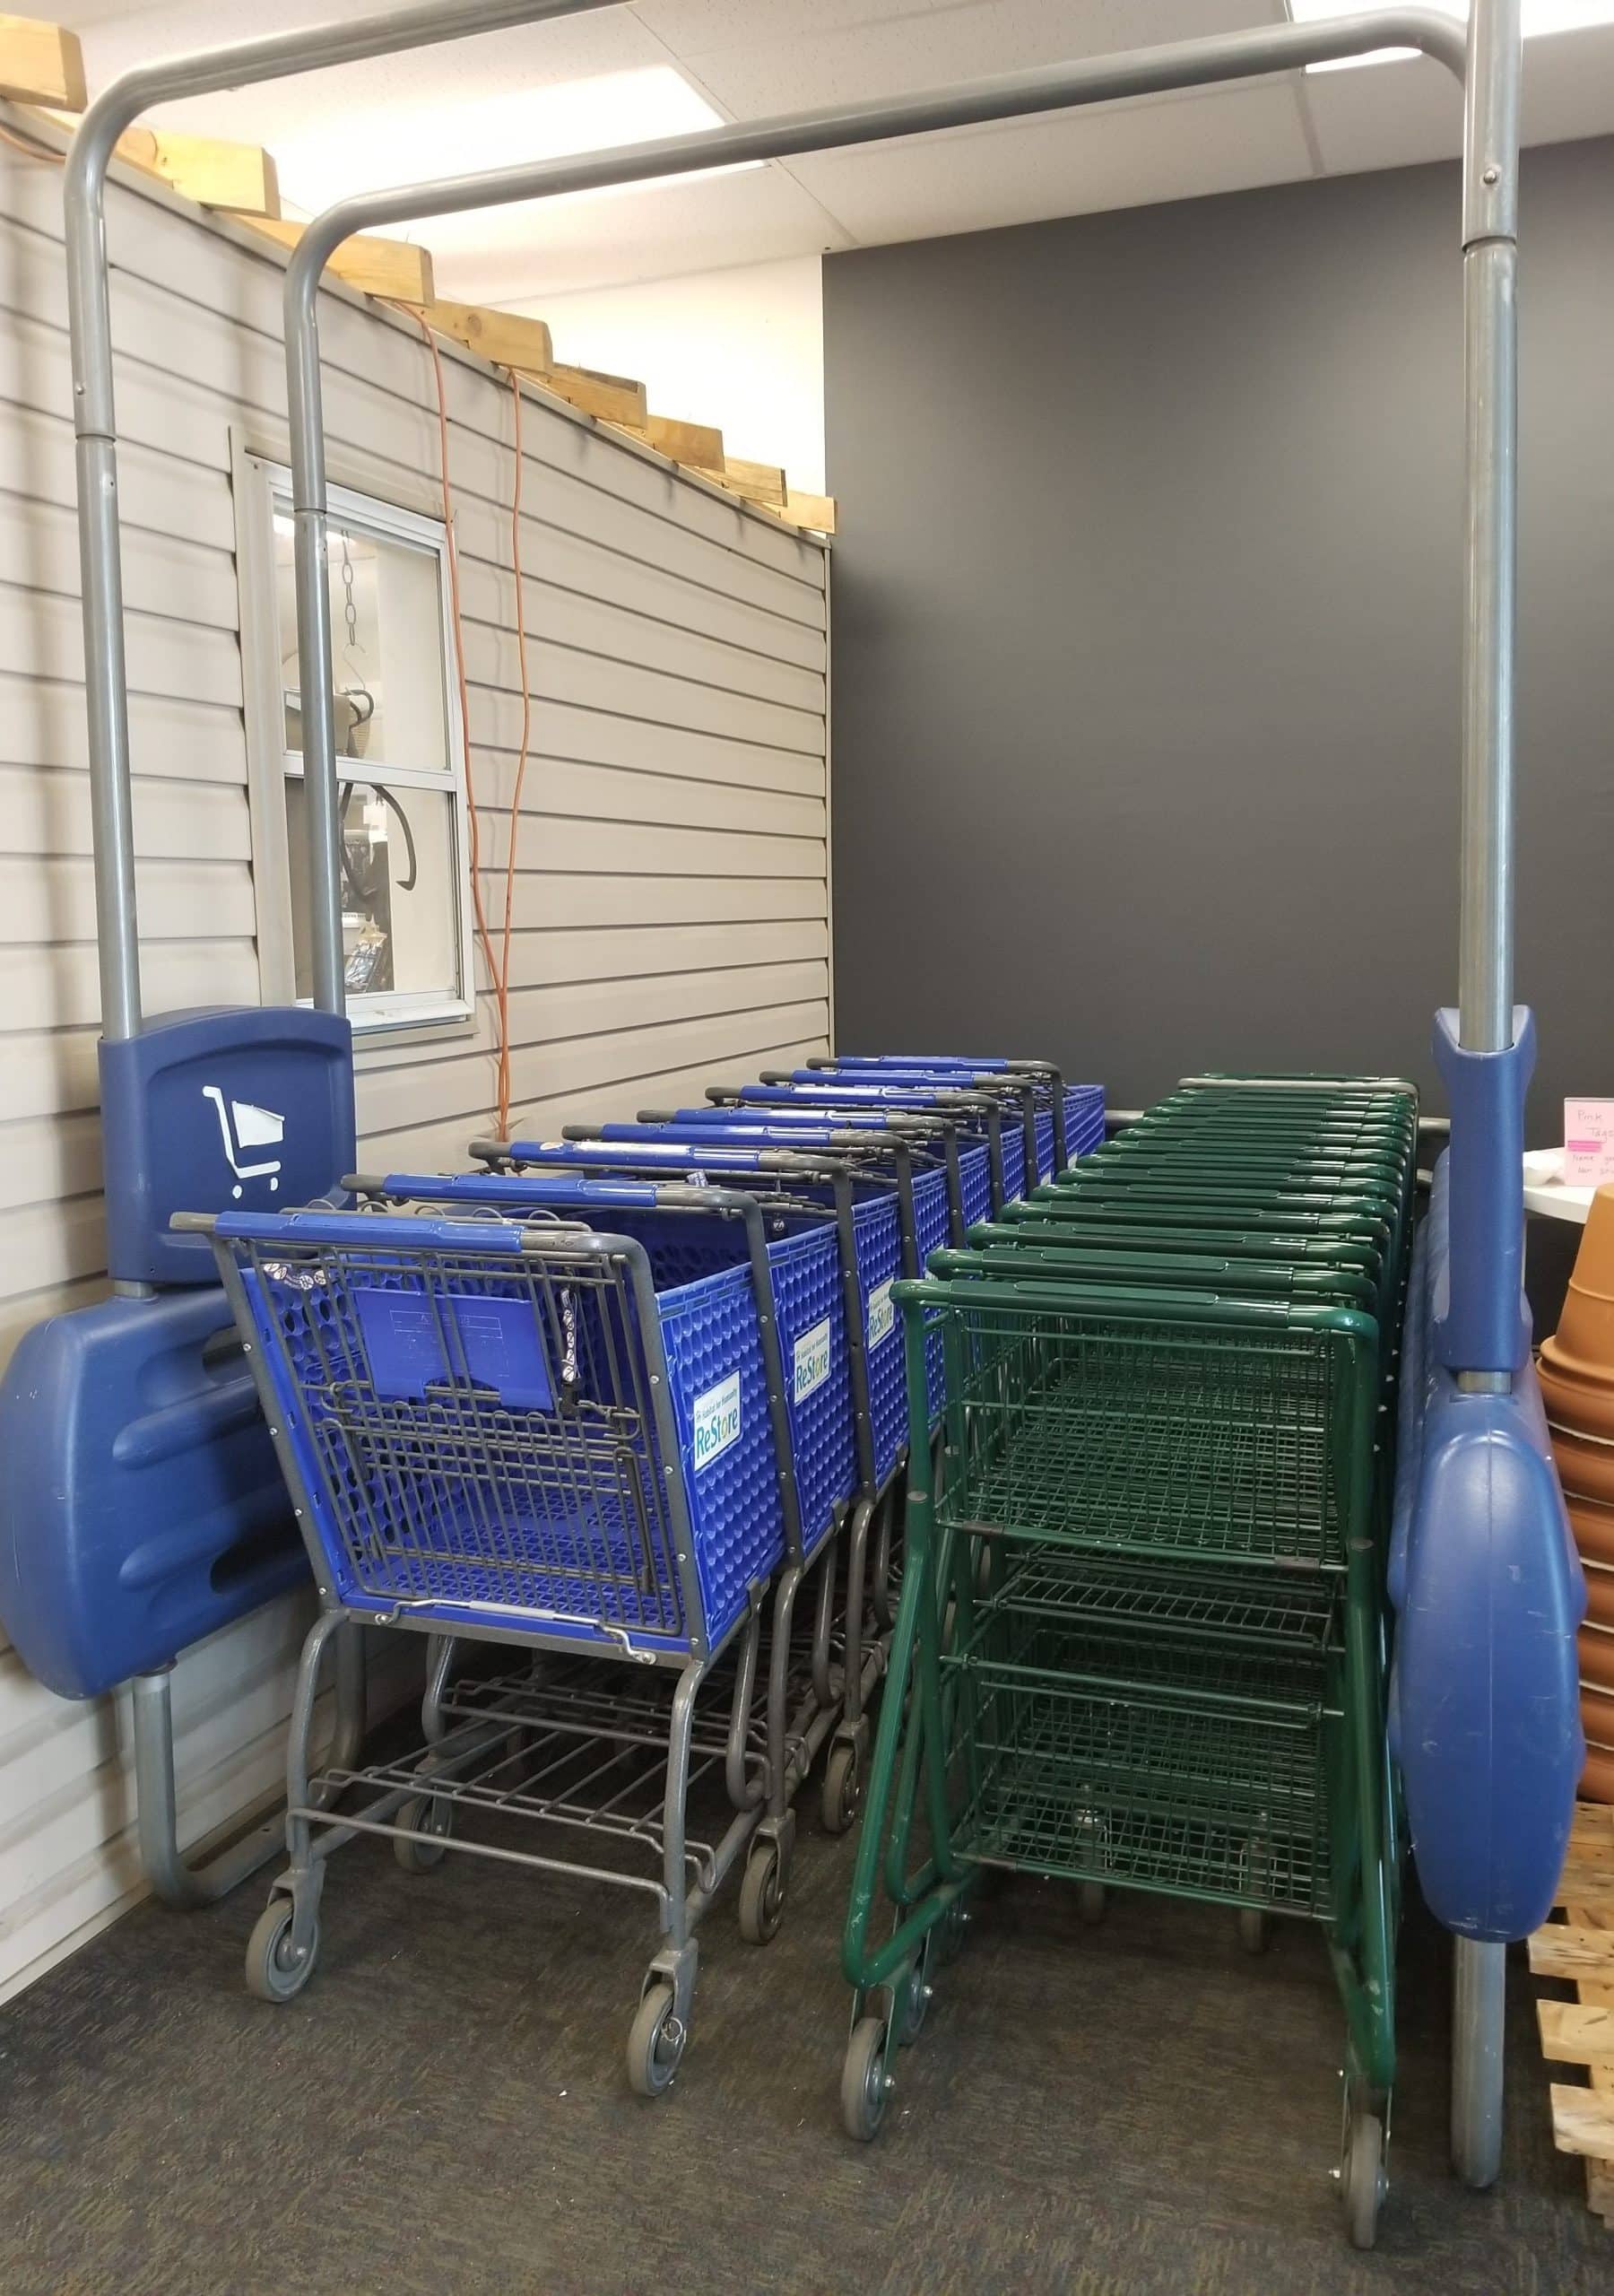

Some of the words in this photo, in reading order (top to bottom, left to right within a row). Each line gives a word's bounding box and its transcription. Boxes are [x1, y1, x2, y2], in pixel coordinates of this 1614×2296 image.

[869, 1303, 892, 1342] ReStore
[796, 1349, 828, 1394] ReStore
[696, 1406, 738, 1459] ReStore
